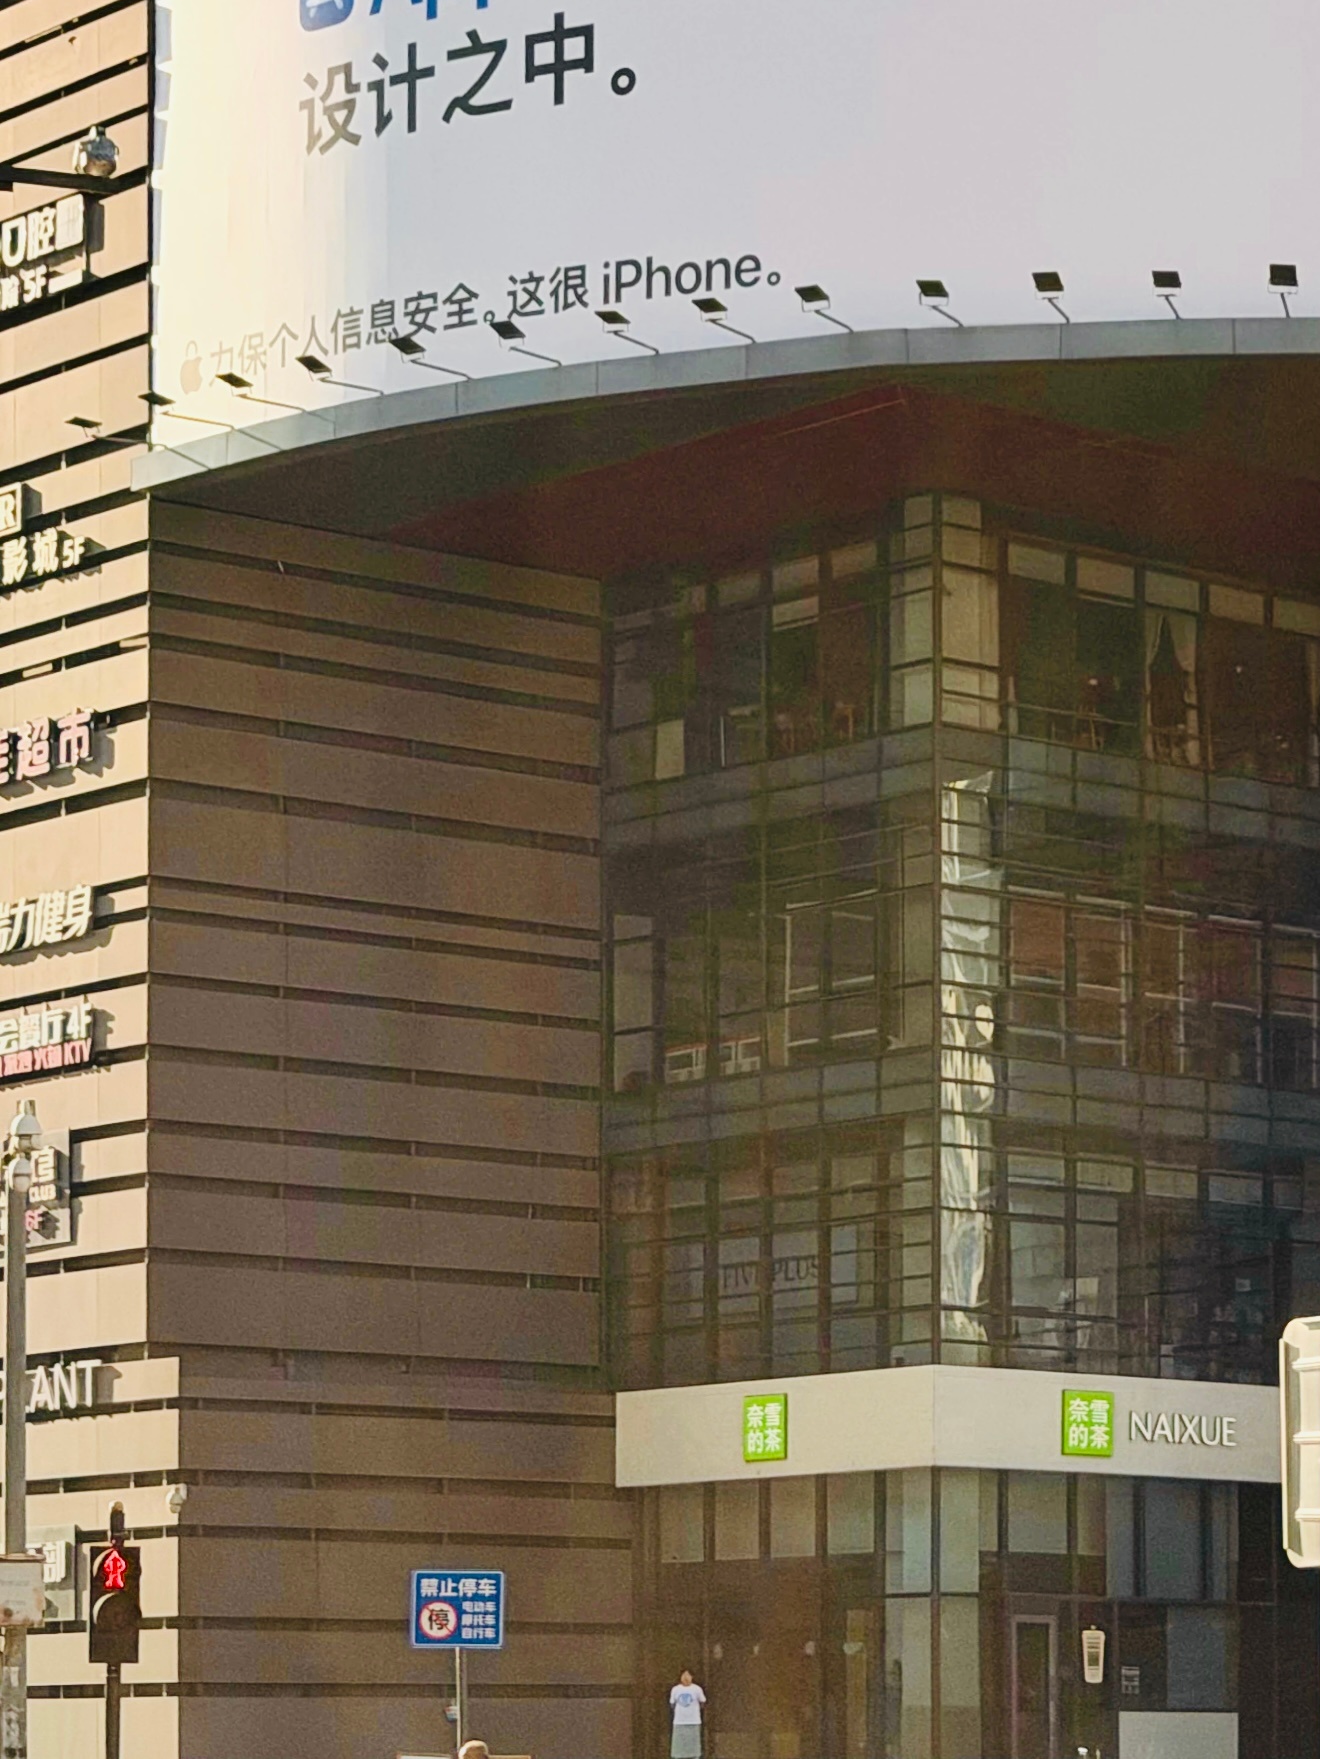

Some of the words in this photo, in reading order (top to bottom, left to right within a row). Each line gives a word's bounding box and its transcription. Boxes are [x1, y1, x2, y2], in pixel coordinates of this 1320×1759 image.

[299, 11, 637, 156] 设计之中。
[25, 1358, 102, 1413] ANT
[747, 1403, 782, 1429] 奈雪
[1069, 1398, 1110, 1424] 奈雪
[747, 1428, 782, 1454] 的茶
[1069, 1424, 1110, 1449] 的茶
[1131, 1410, 1237, 1447] NAIXUE
[420, 1577, 497, 1597] 禁止停车
